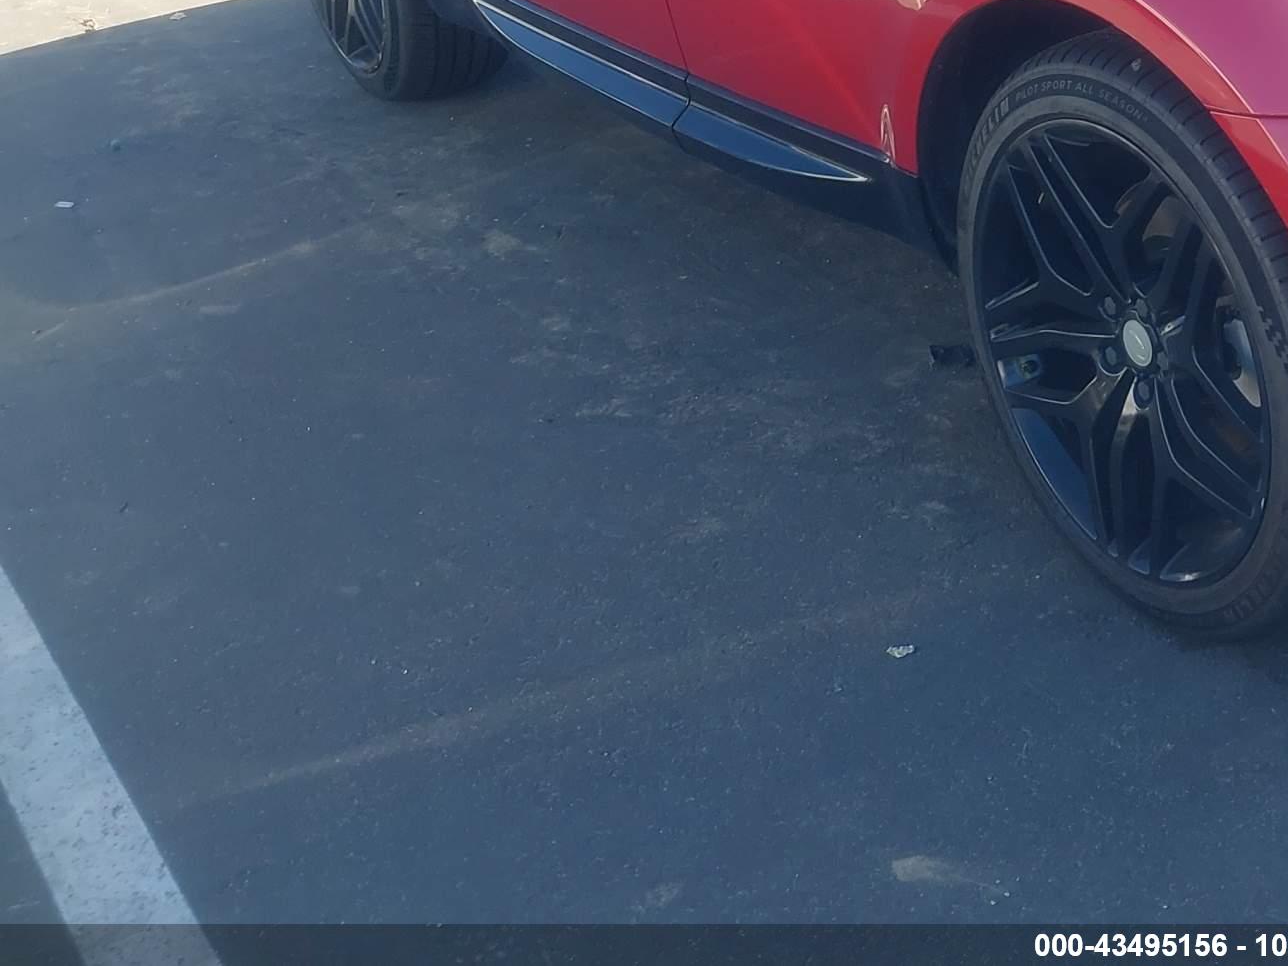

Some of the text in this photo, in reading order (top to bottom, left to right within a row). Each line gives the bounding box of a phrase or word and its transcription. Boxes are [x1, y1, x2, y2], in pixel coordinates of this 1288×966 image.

[1040, 79, 1073, 93] SPORT
[1075, 82, 1094, 96] ALL
[1098, 88, 1144, 120] SEASON
